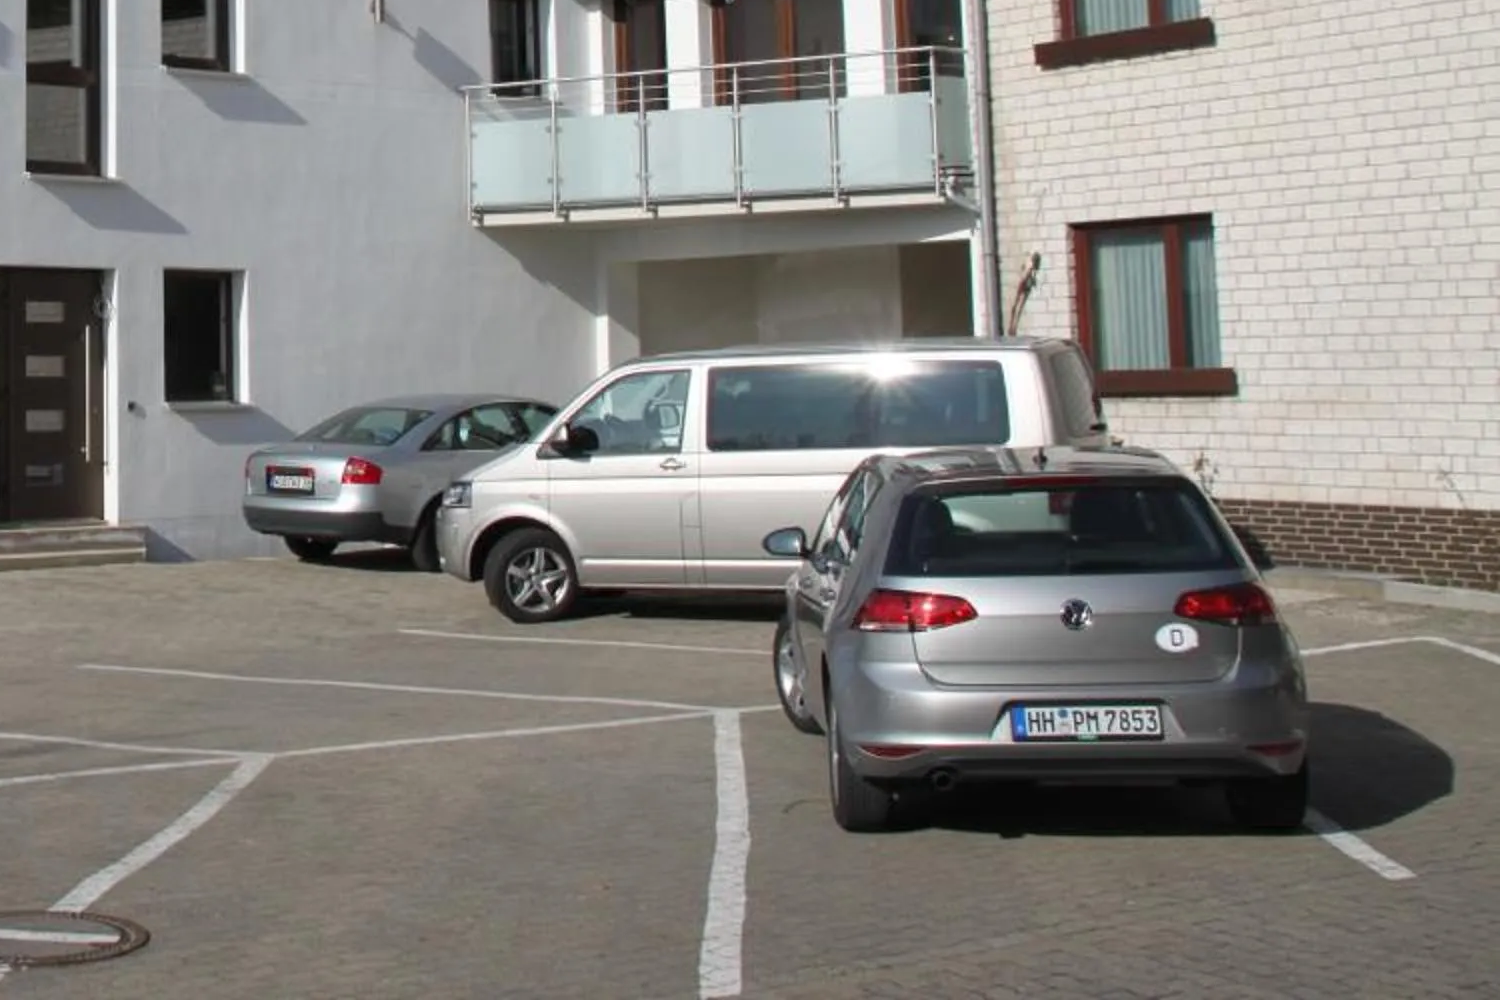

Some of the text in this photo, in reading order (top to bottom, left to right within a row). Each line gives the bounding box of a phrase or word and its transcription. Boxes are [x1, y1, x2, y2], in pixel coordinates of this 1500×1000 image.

[1169, 628, 1184, 647] D
[1027, 709, 1158, 733] HH PM 7853
